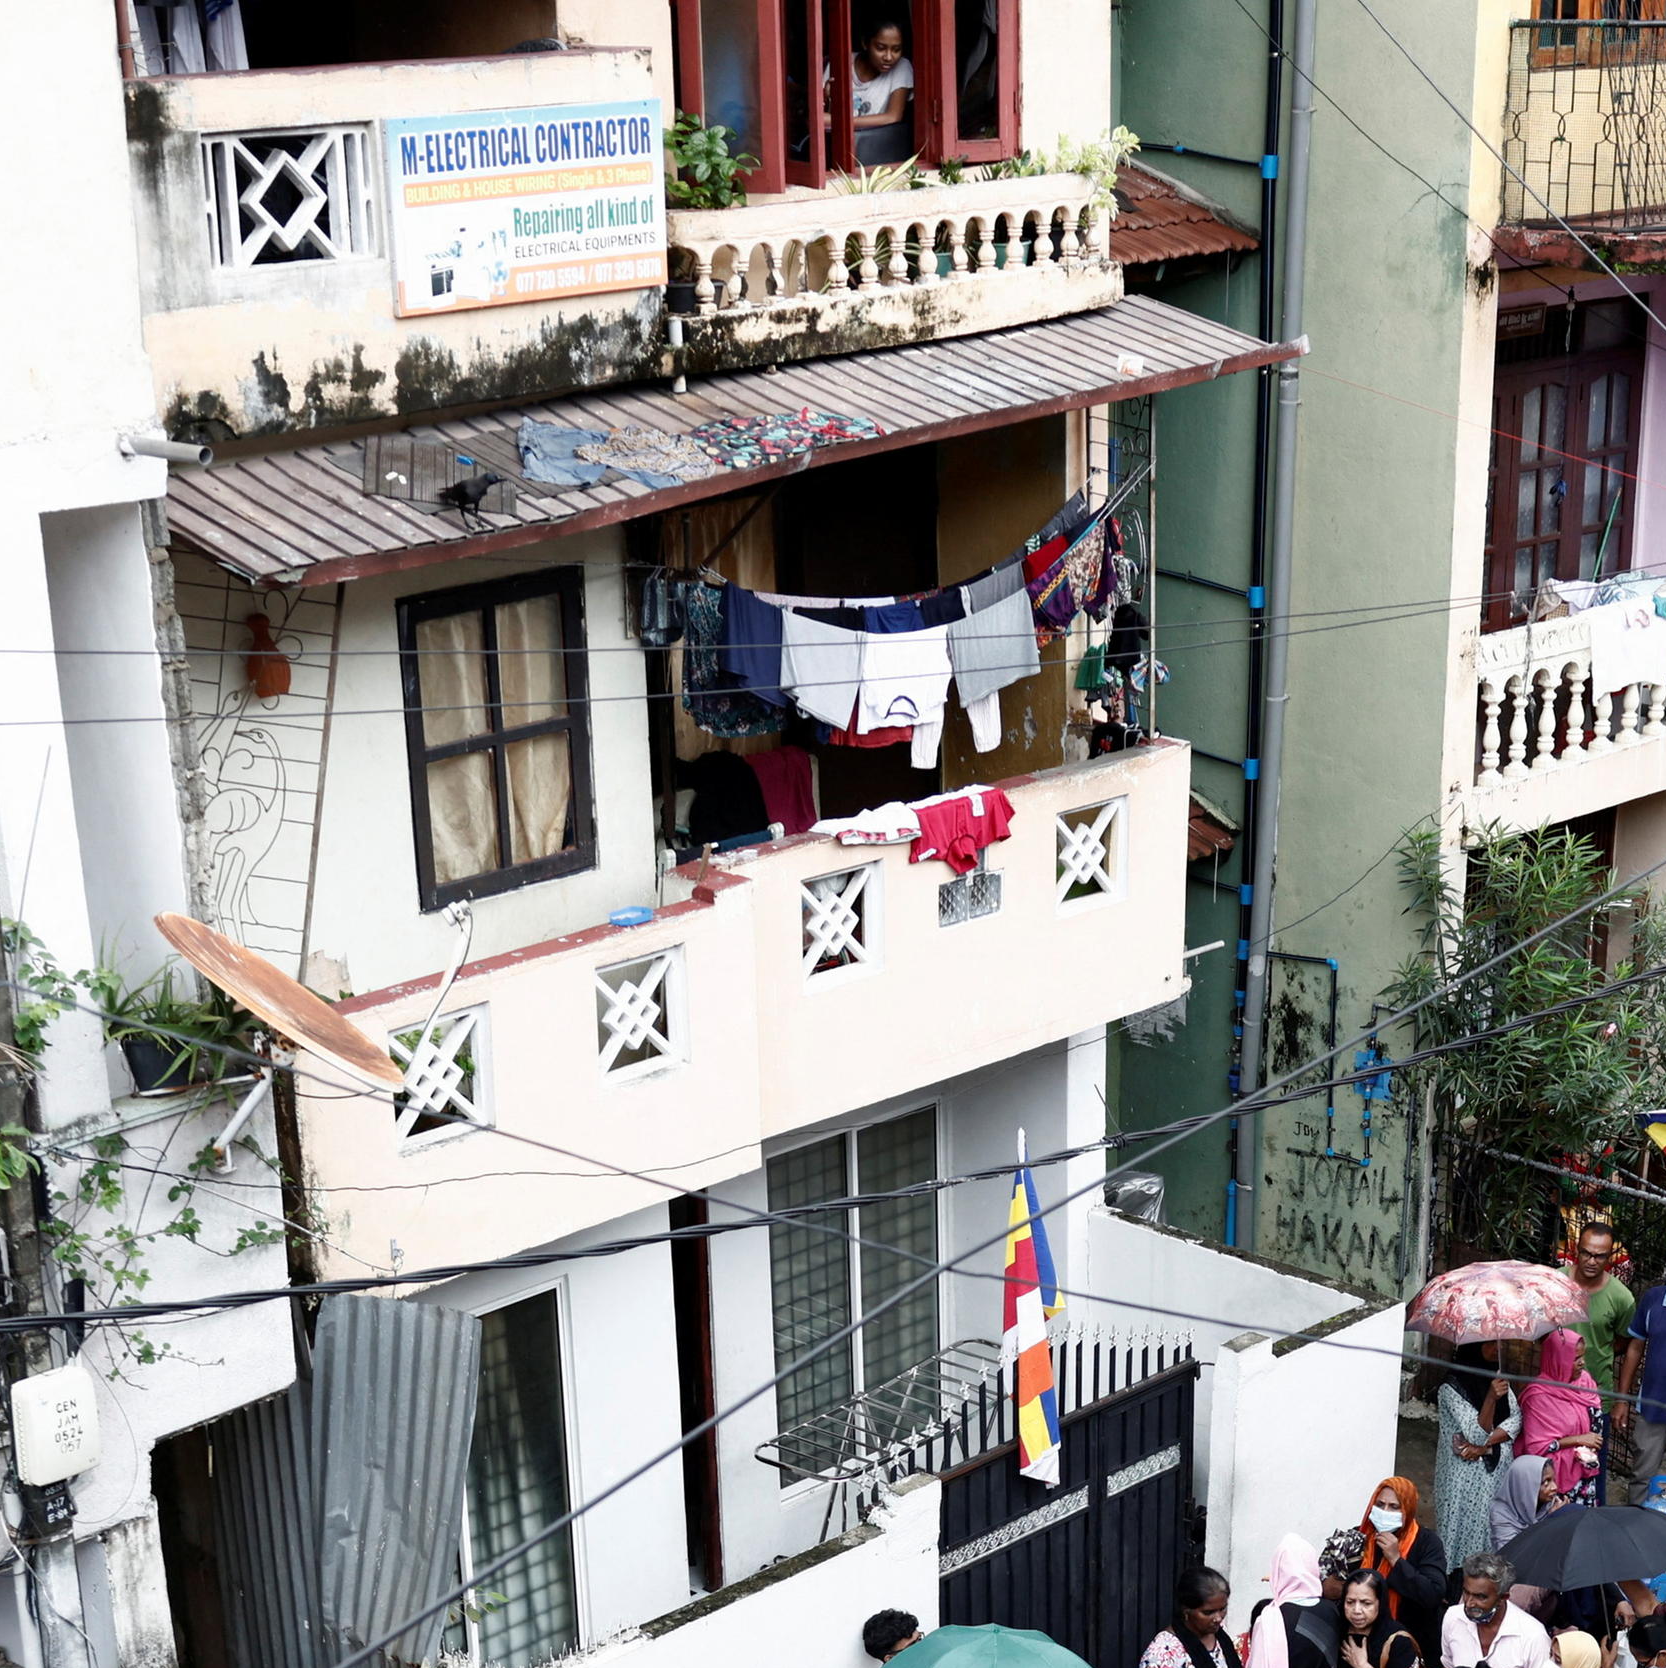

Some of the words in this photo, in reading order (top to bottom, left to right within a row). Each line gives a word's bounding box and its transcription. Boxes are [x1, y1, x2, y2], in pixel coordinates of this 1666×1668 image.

[400, 126, 531, 176] M-ELECTRICAL
[535, 117, 652, 163] CONTRACTOR
[406, 184, 461, 203] BUILDING
[463, 183, 471, 197] &
[473, 178, 513, 197] HOUSE
[515, 173, 555, 193] WIRING
[557, 170, 595, 191] (Single
[607, 169, 614, 184] 3
[616, 165, 653, 185] Phase)
[513, 203, 582, 238] Repairing
[587, 199, 604, 229] all
[607, 196, 637, 228] kind
[641, 194, 654, 224] of
[515, 240, 582, 259] ELECTRICAL
[585, 231, 656, 251] EQUIPMENTS
[515, 270, 533, 293] 077
[57, 1414, 80, 1428] JAM
